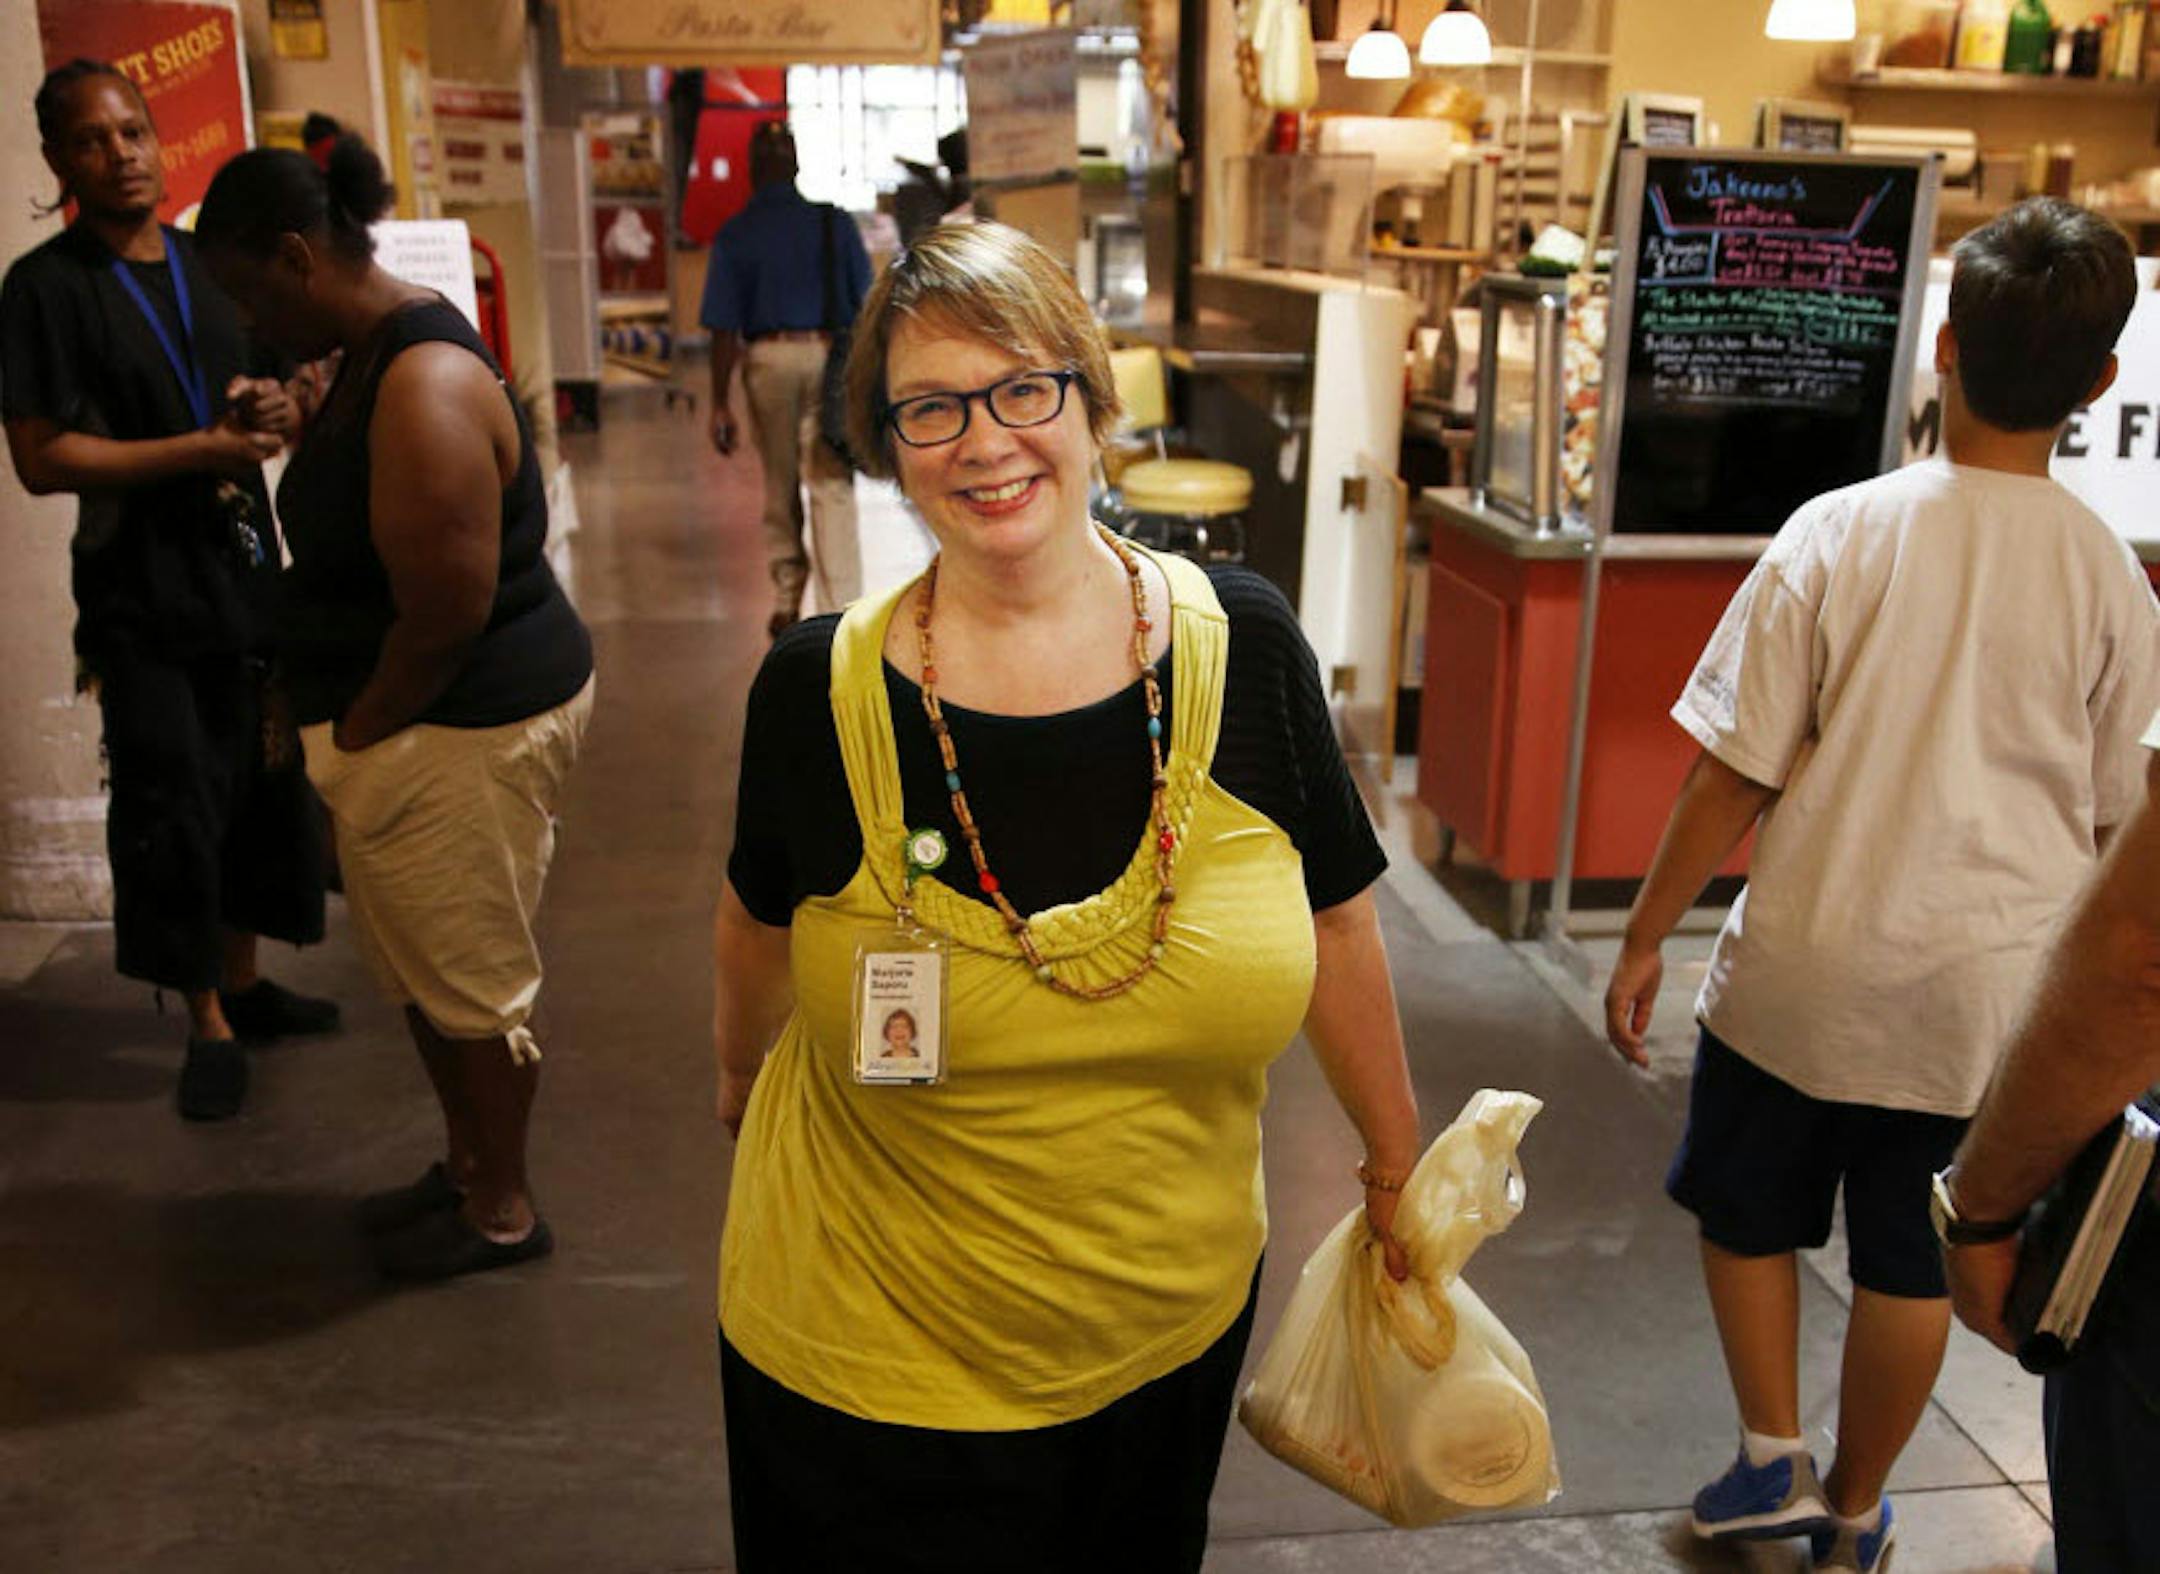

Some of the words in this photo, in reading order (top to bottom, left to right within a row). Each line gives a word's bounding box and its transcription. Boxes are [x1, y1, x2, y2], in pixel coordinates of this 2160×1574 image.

[656, 8, 753, 39] Pasta
[765, 5, 832, 38] Bar
[151, 17, 225, 78] SHOES
